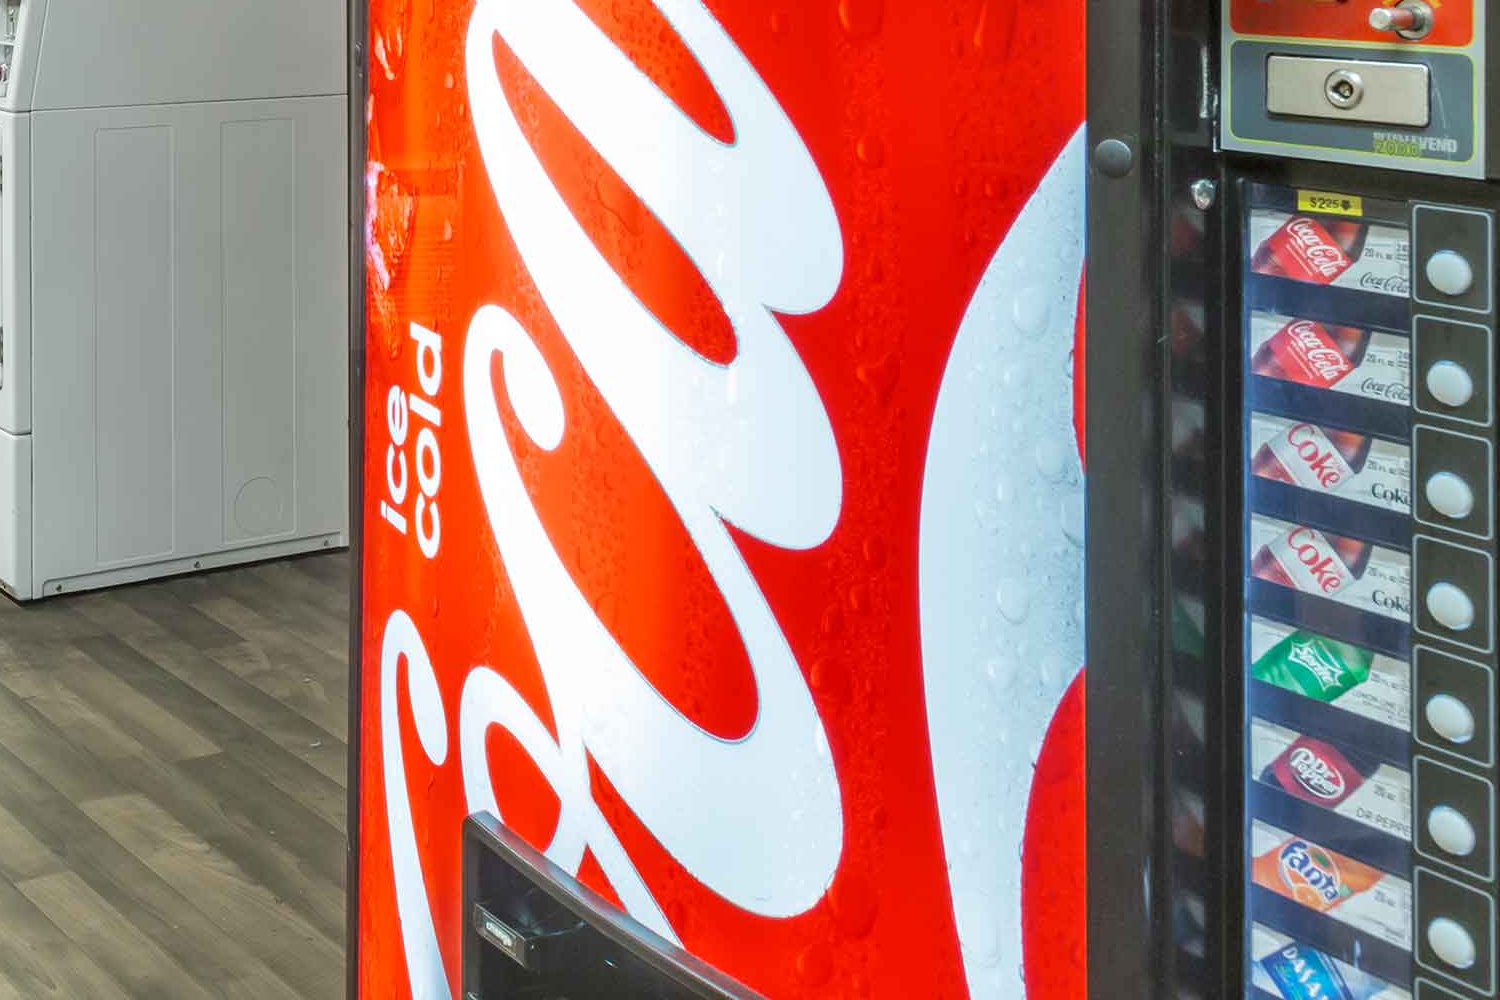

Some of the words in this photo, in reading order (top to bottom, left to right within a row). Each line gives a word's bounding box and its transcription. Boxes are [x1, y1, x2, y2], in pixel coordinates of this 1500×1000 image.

[1286, 218, 1348, 278] Coca-Cola
[1287, 320, 1349, 382] Coca-Cola
[381, 384, 408, 535] ice
[409, 321, 442, 560] cold
[1287, 424, 1341, 489] Coke
[1287, 524, 1341, 594] Coke
[1376, 814, 1412, 838] PEPPE
[1281, 841, 1340, 901] Fanta
[1283, 946, 1328, 1000] DASA
